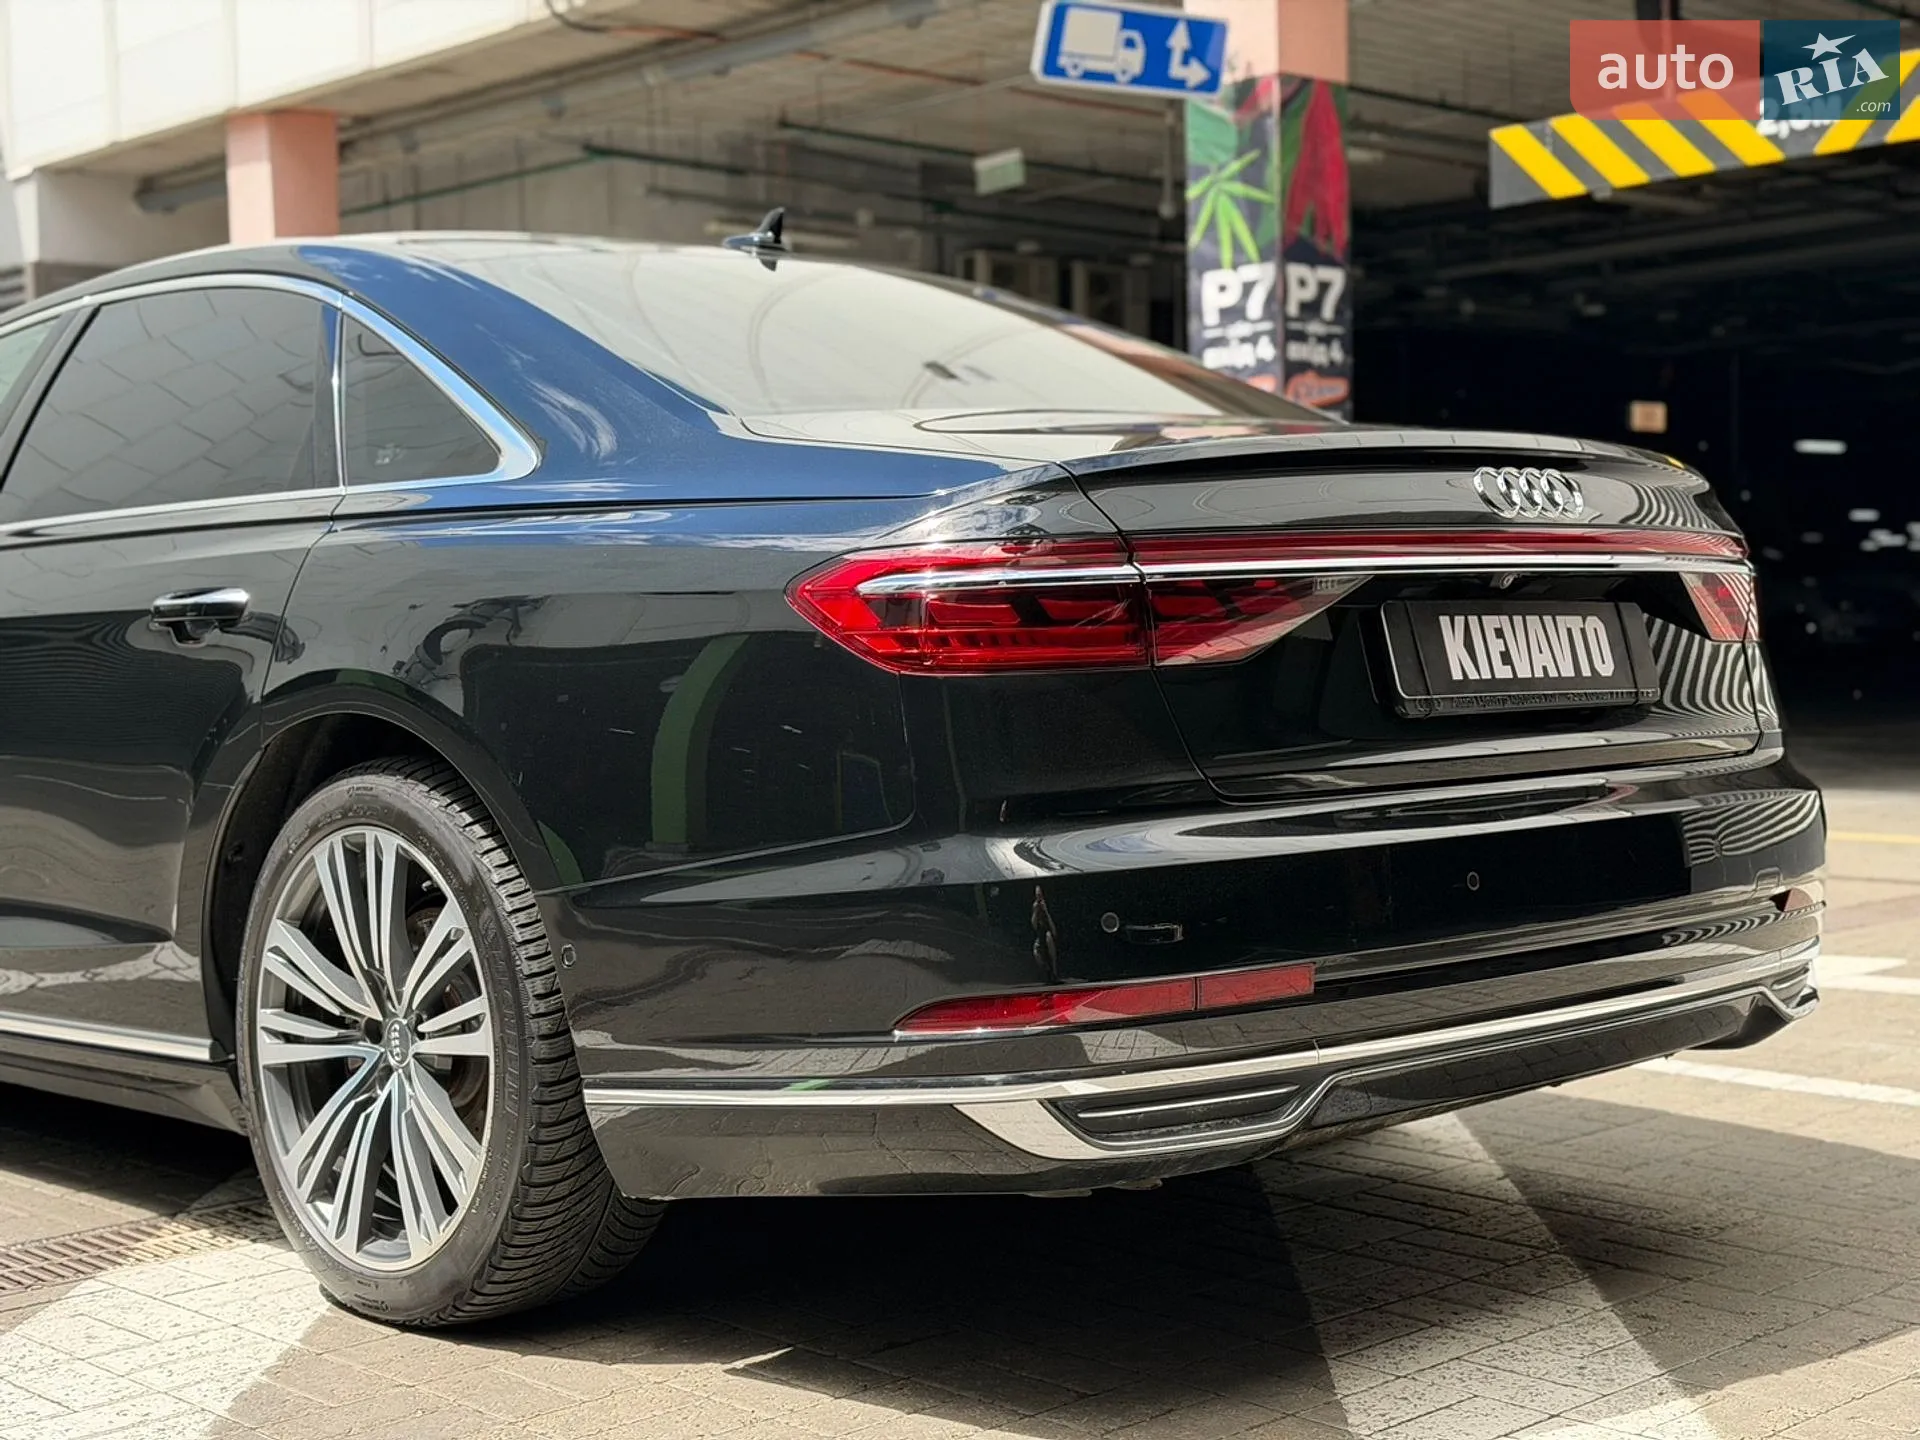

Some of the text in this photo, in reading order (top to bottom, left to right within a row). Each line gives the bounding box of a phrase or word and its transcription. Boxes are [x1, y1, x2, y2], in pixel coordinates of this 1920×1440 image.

[1201, 261, 1276, 327] P7
[1286, 262, 1346, 322] P7
[1438, 615, 1615, 680] KIEVAVTO
